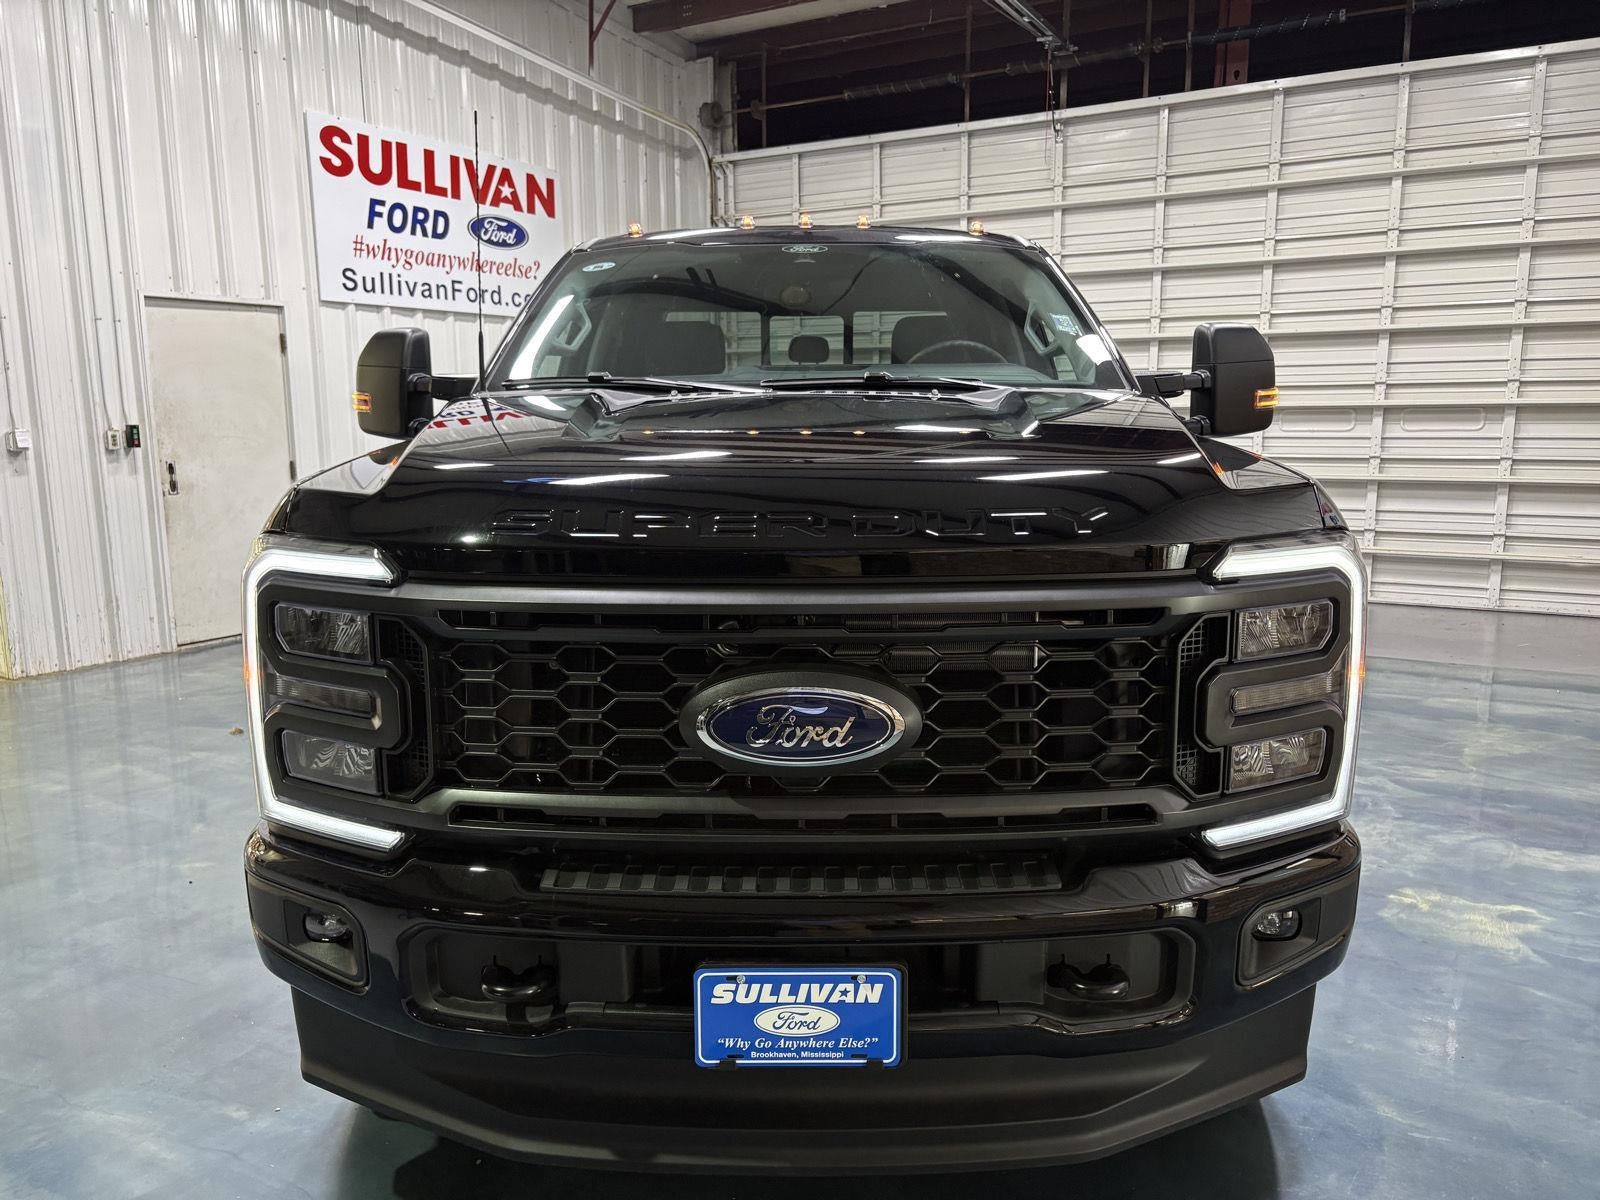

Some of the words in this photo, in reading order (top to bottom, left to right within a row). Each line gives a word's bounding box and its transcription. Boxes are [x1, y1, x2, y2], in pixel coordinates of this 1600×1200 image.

[319, 125, 556, 219] SULLIVAN
[367, 197, 450, 240] FORD
[479, 217, 517, 245] Ford
[353, 234, 541, 280] #whygoanywhereelse?
[491, 508, 827, 538] SUPER
[851, 506, 1109, 537] DUTY
[746, 704, 856, 748] Ford
[710, 983, 884, 1004] SULLIVAN
[772, 1011, 821, 1031] Ford
[754, 1038, 772, 1049] Go
[775, 1038, 834, 1050] Anywhere
[800, 1051, 844, 1059] Mississippi
